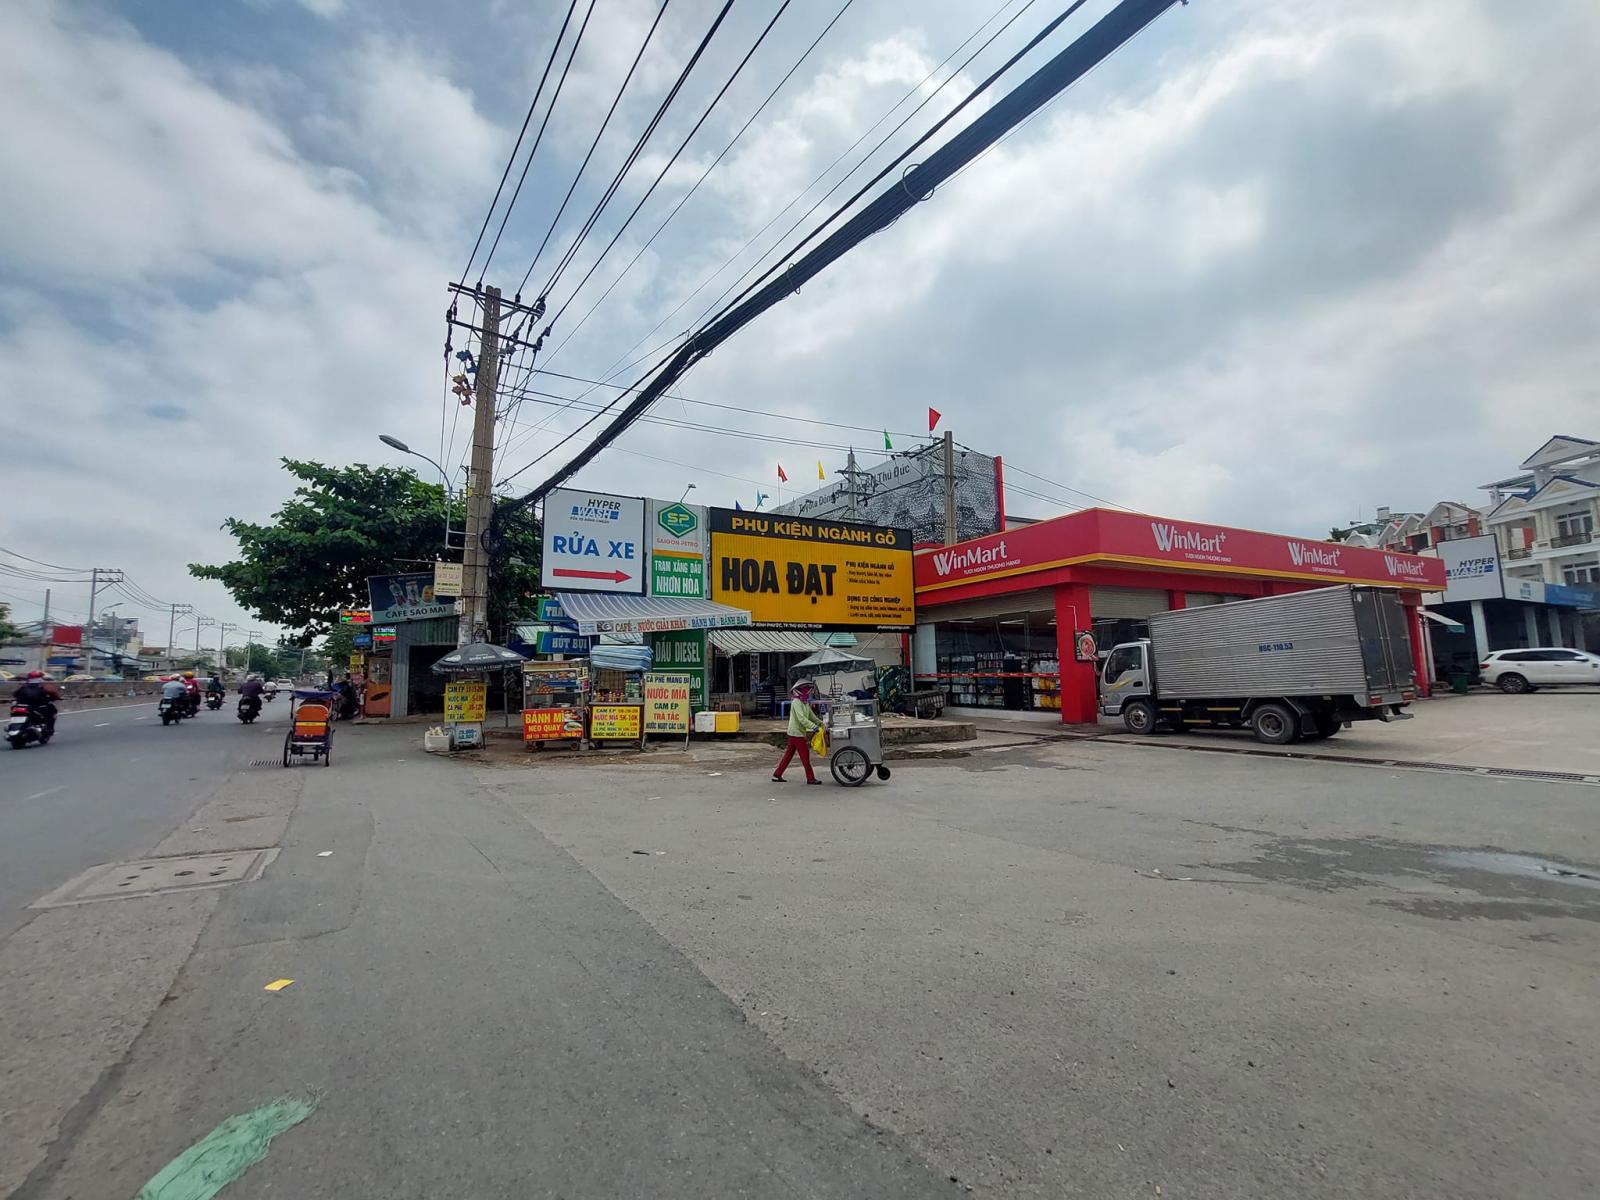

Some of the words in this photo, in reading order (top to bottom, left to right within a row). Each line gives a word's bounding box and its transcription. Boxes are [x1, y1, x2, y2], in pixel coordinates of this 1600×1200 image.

[588, 499, 621, 510] HYPER
[667, 512, 690, 524] SP
[732, 517, 768, 535] PHỤ
[774, 521, 813, 539] KIỆN
[818, 525, 871, 543] NGÀNH
[874, 529, 896, 546] GỖ
[553, 530, 600, 557] RỬA
[607, 540, 635, 559] XE
[933, 541, 1007, 577] WinMart
[1460, 557, 1495, 568] HYPER
[654, 560, 672, 574] TRẠM
[656, 575, 681, 593] NHƠN
[721, 556, 779, 594] HOA
[786, 562, 837, 604] ĐẠT
[410, 608, 428, 617] SAO
[430, 606, 447, 615] MAI
[637, 620, 655, 631] NƯỚC
[721, 616, 736, 625] BÁNH
[736, 615, 748, 625] BAO
[675, 641, 701, 663] DIESEL
[666, 675, 682, 683] MANG
[647, 687, 669, 699] NƯỚC
[525, 711, 551, 724] BÁNH
[543, 724, 560, 732] QUAY
